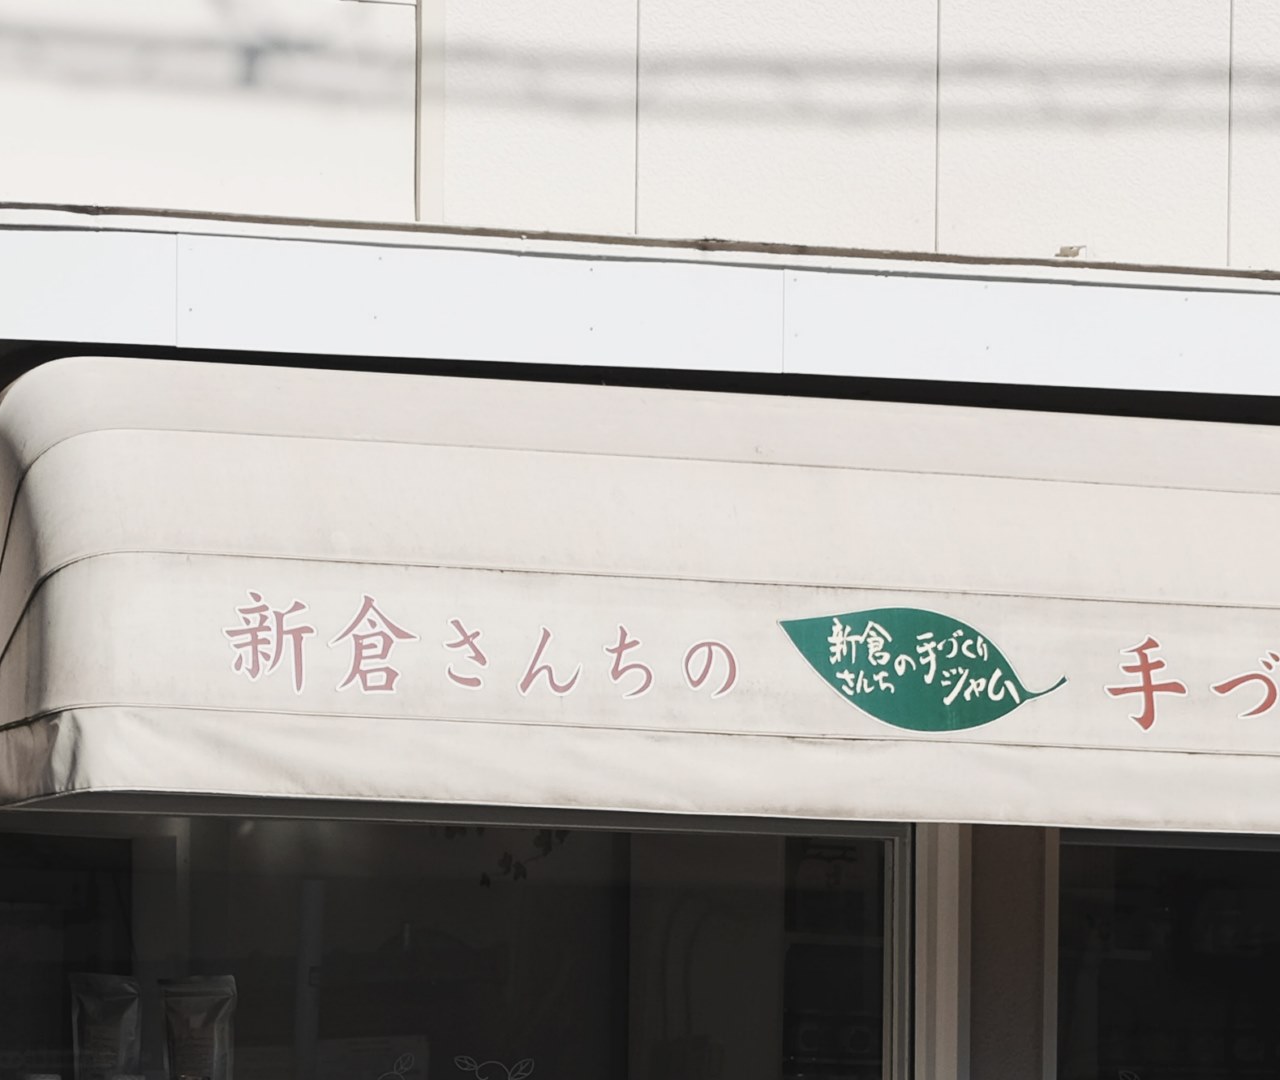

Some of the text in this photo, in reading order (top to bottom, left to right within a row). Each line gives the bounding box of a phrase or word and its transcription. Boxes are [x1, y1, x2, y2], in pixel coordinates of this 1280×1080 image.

[223, 591, 738, 699] 新倉さんちの
[827, 617, 892, 666] 新倉
[916, 629, 988, 685] 手づくり
[836, 669, 895, 696] さんち
[941, 666, 1021, 706] ジャム
